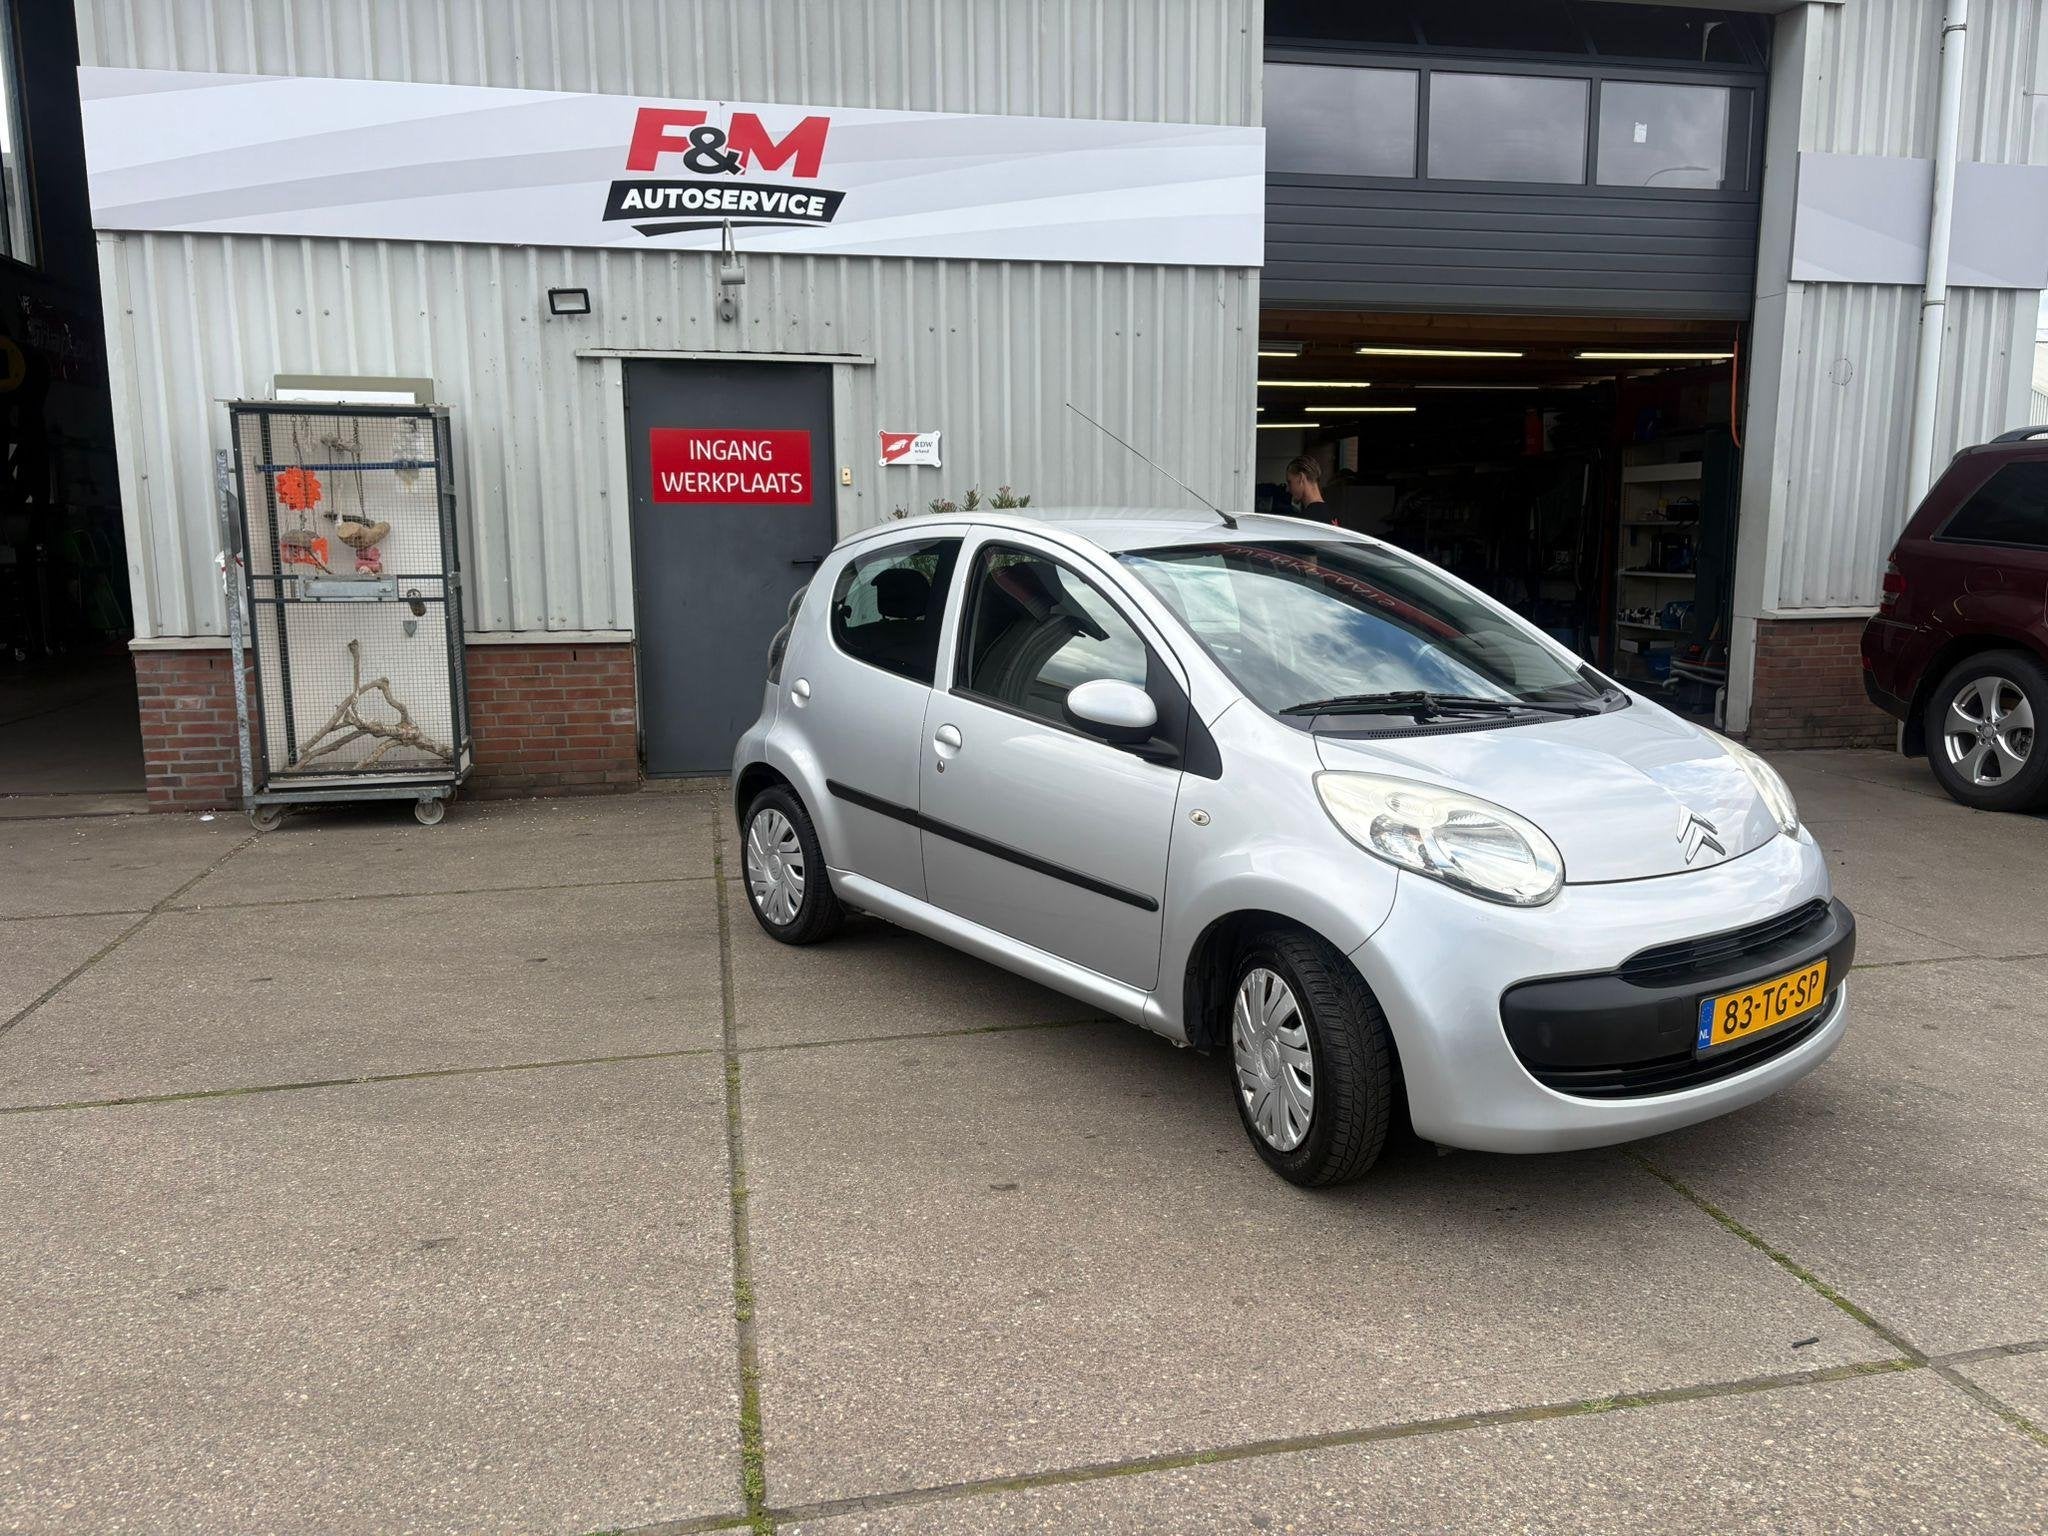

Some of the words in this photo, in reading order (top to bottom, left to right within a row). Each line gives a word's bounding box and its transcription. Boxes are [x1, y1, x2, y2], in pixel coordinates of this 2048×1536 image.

[625, 107, 831, 179] F&M
[620, 188, 827, 217] AUTOSERVICE
[689, 439, 773, 462] INGANG
[661, 471, 804, 494] WERKPLAATS
[1723, 969, 1820, 1035] 83-TG-SP
[1699, 1029, 1710, 1041] NL
